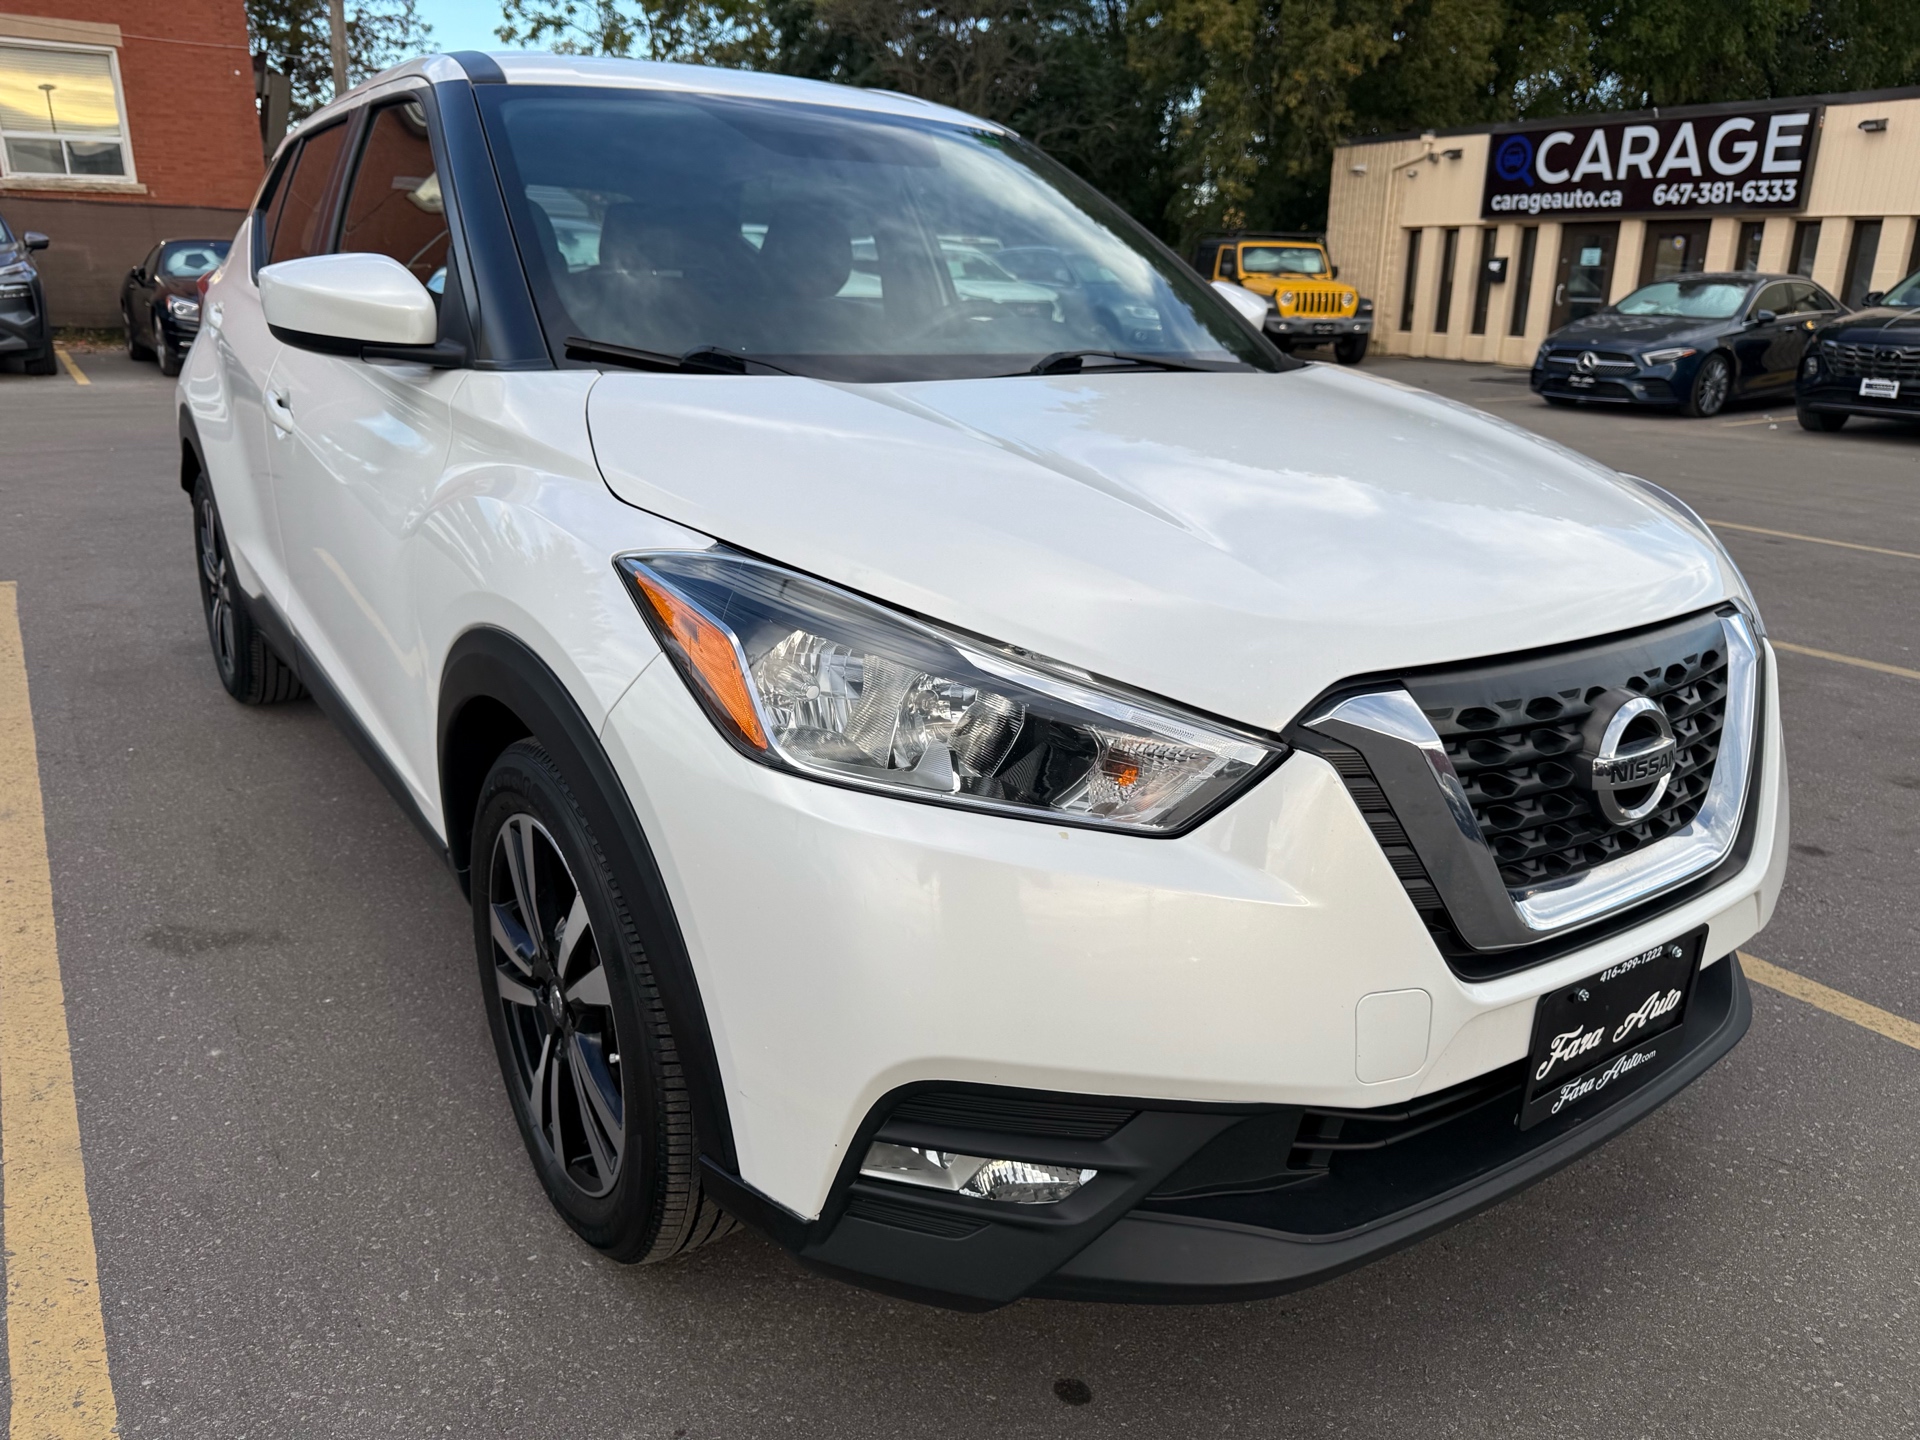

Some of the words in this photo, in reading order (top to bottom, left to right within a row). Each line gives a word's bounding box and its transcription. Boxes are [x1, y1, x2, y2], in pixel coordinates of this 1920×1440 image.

[1536, 113, 1810, 184] CARAGE
[1491, 189, 1623, 214] carageauto.ca
[1652, 179, 1798, 206] 647-381-6333
[1610, 750, 1674, 784] NISSAN
[1600, 945, 1663, 983] 416-299-1222
[1535, 1024, 1605, 1081] Fara
[1612, 988, 1682, 1043] Auto
[1551, 1077, 1595, 1114] Fara
[1595, 1049, 1657, 1091] Auto.com
